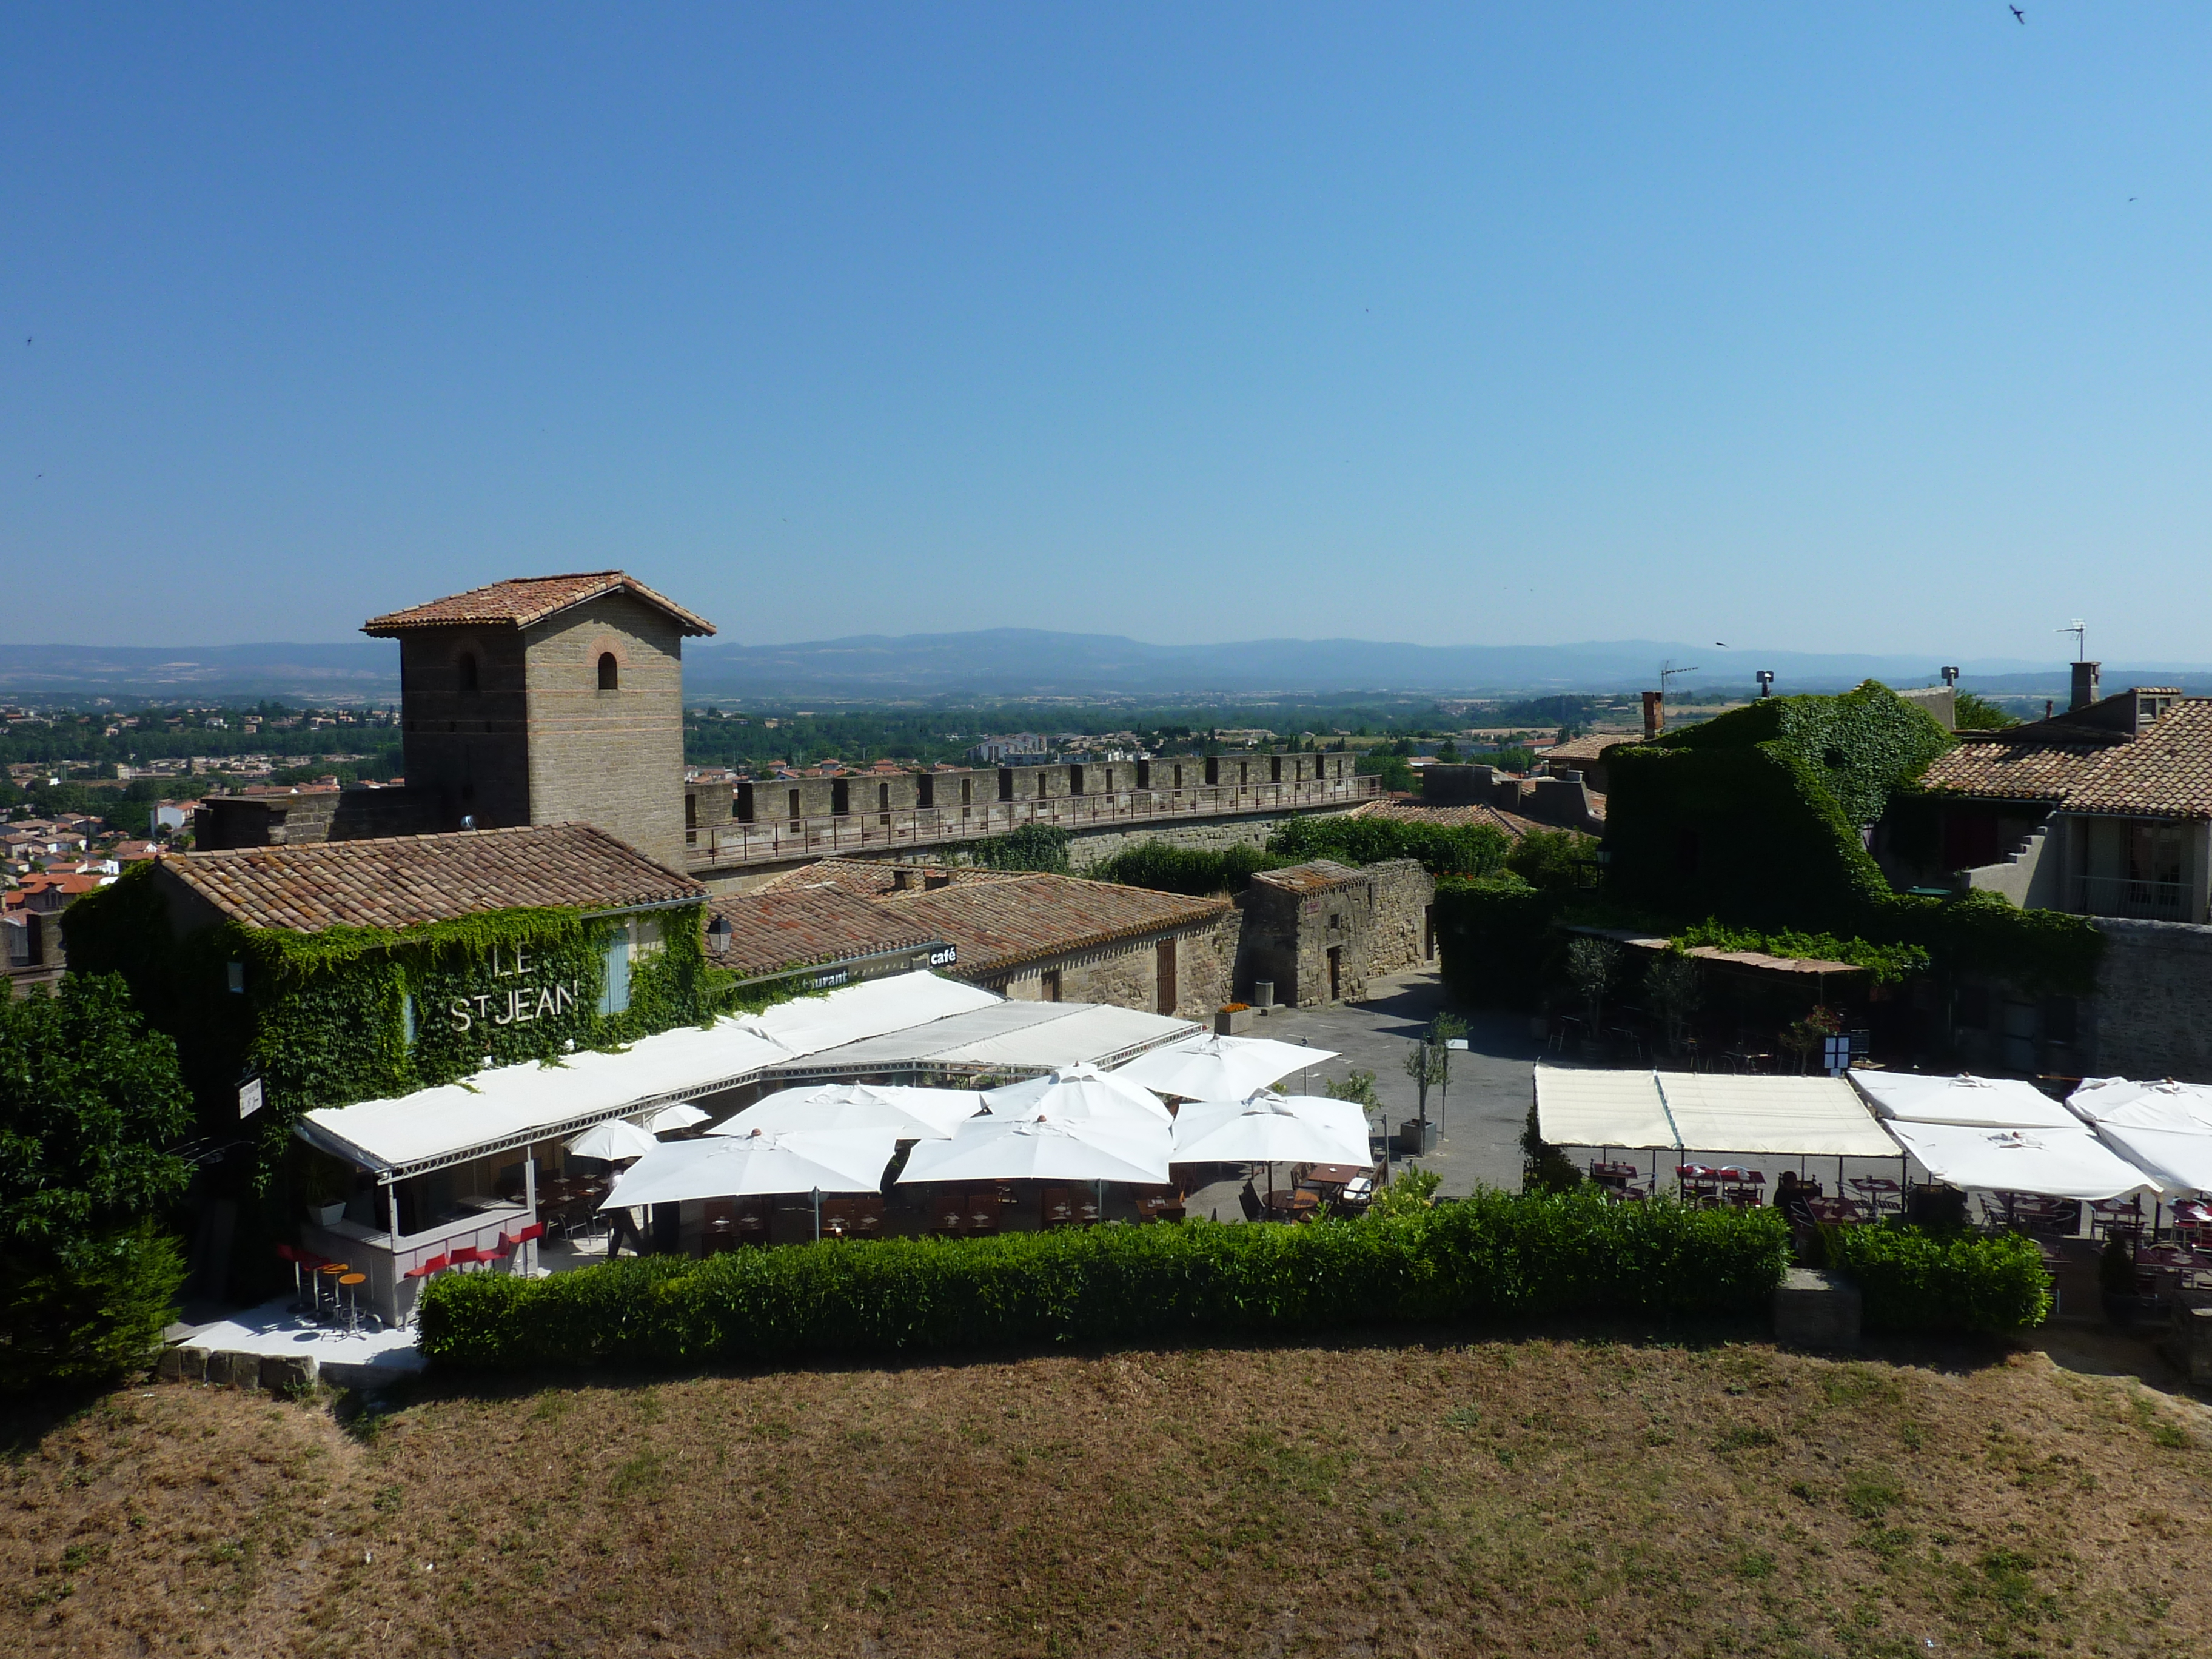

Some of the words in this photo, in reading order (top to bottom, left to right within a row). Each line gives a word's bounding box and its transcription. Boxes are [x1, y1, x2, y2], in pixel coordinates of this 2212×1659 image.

[494, 941, 534, 977] LE
[931, 947, 956, 965] café
[495, 980, 578, 1025] JEAN
